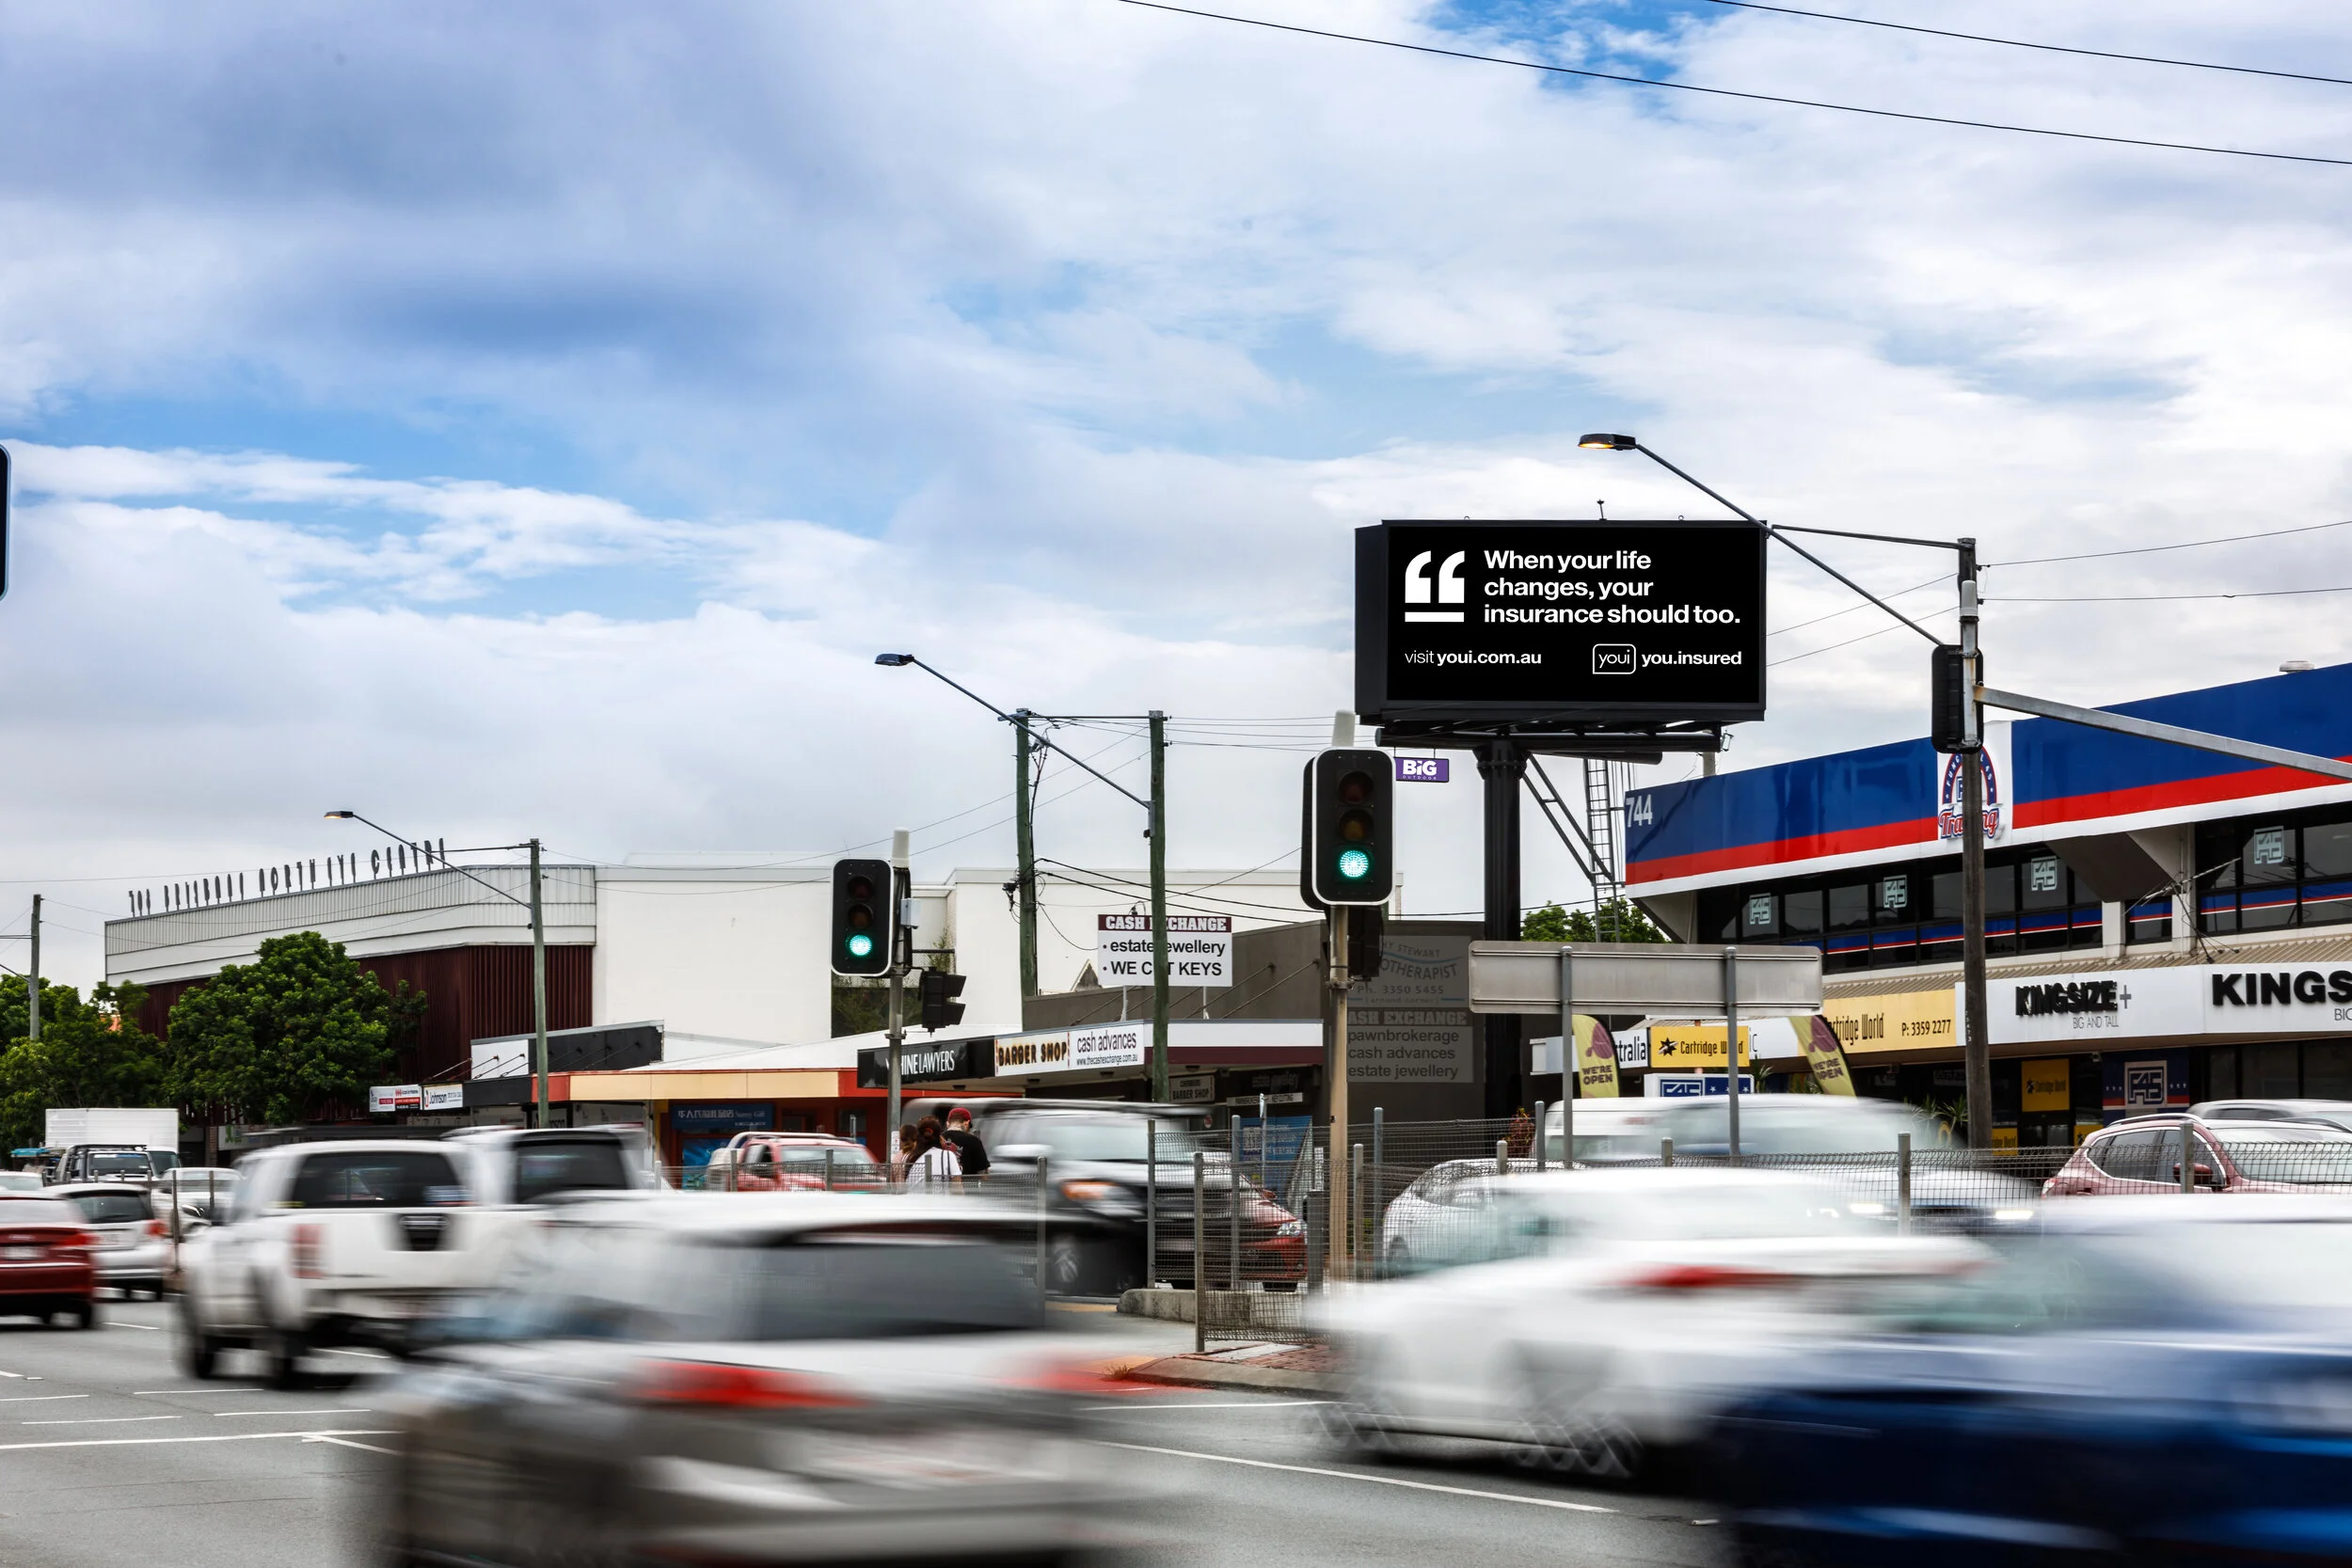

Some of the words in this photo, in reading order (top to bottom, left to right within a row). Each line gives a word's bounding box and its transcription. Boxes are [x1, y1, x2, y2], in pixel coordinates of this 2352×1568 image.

[1484, 550, 1553, 569] When
[1557, 555, 1613, 573] your
[1616, 550, 1651, 569] life
[1484, 577, 1595, 600] changes,
[1598, 581, 1654, 600] your
[1484, 604, 1603, 623] insurance
[1607, 604, 1690, 624] should
[1692, 605, 1740, 624] too.
[1405, 650, 1435, 664] visit
[1437, 650, 1542, 667] youi.com.au
[1598, 649, 1630, 669] youi
[1641, 651, 1742, 667] you.insured
[1626, 794, 1653, 828] 744
[1938, 808, 1999, 839] Trang
[1105, 916, 1145, 930] CASH
[1150, 916, 1227, 931] CHANGE
[1110, 940, 1154, 952] estate
[1167, 940, 1226, 957] ewellery
[1397, 943, 1440, 958] STEWART
[1111, 961, 1136, 974] WE
[1141, 961, 1174, 975] CT
[1179, 962, 1222, 975] KEYS
[1381, 958, 1458, 980] OTHERAPIST
[1383, 985, 1411, 994] 3350
[1415, 985, 1444, 994] 5455
[1347, 1010, 1379, 1025] ASH
[1383, 1010, 1467, 1025] EXCHANGE
[1861, 1012, 1884, 1040] World
[2073, 1016, 2085, 1029] BIG
[2087, 1016, 2103, 1028] AND
[2105, 1015, 2119, 1028] TALL
[1347, 1028, 1459, 1044] pawnbrokerage
[1901, 1022, 1910, 1037] P:
[1911, 1021, 1931, 1037] 3359
[1931, 1019, 1952, 1035] 2277
[1077, 1031, 1096, 1053] cash
[1098, 1029, 1137, 1050] advances
[1615, 1036, 1646, 1063] tralia
[1680, 1040, 1718, 1057] Cartridge
[998, 1044, 1037, 1067] BARBER
[1041, 1041, 1068, 1063] SHOP
[1347, 1046, 1382, 1059] cash
[1387, 1046, 1455, 1059] advances
[919, 1051, 955, 1073] LAWYERS
[1581, 1064, 1613, 1075] WE'RE
[1347, 1065, 1391, 1077] estate
[1393, 1064, 1459, 1080] jewellery
[1582, 1073, 1613, 1085] OPEN
[2126, 1067, 2165, 1104] F45
